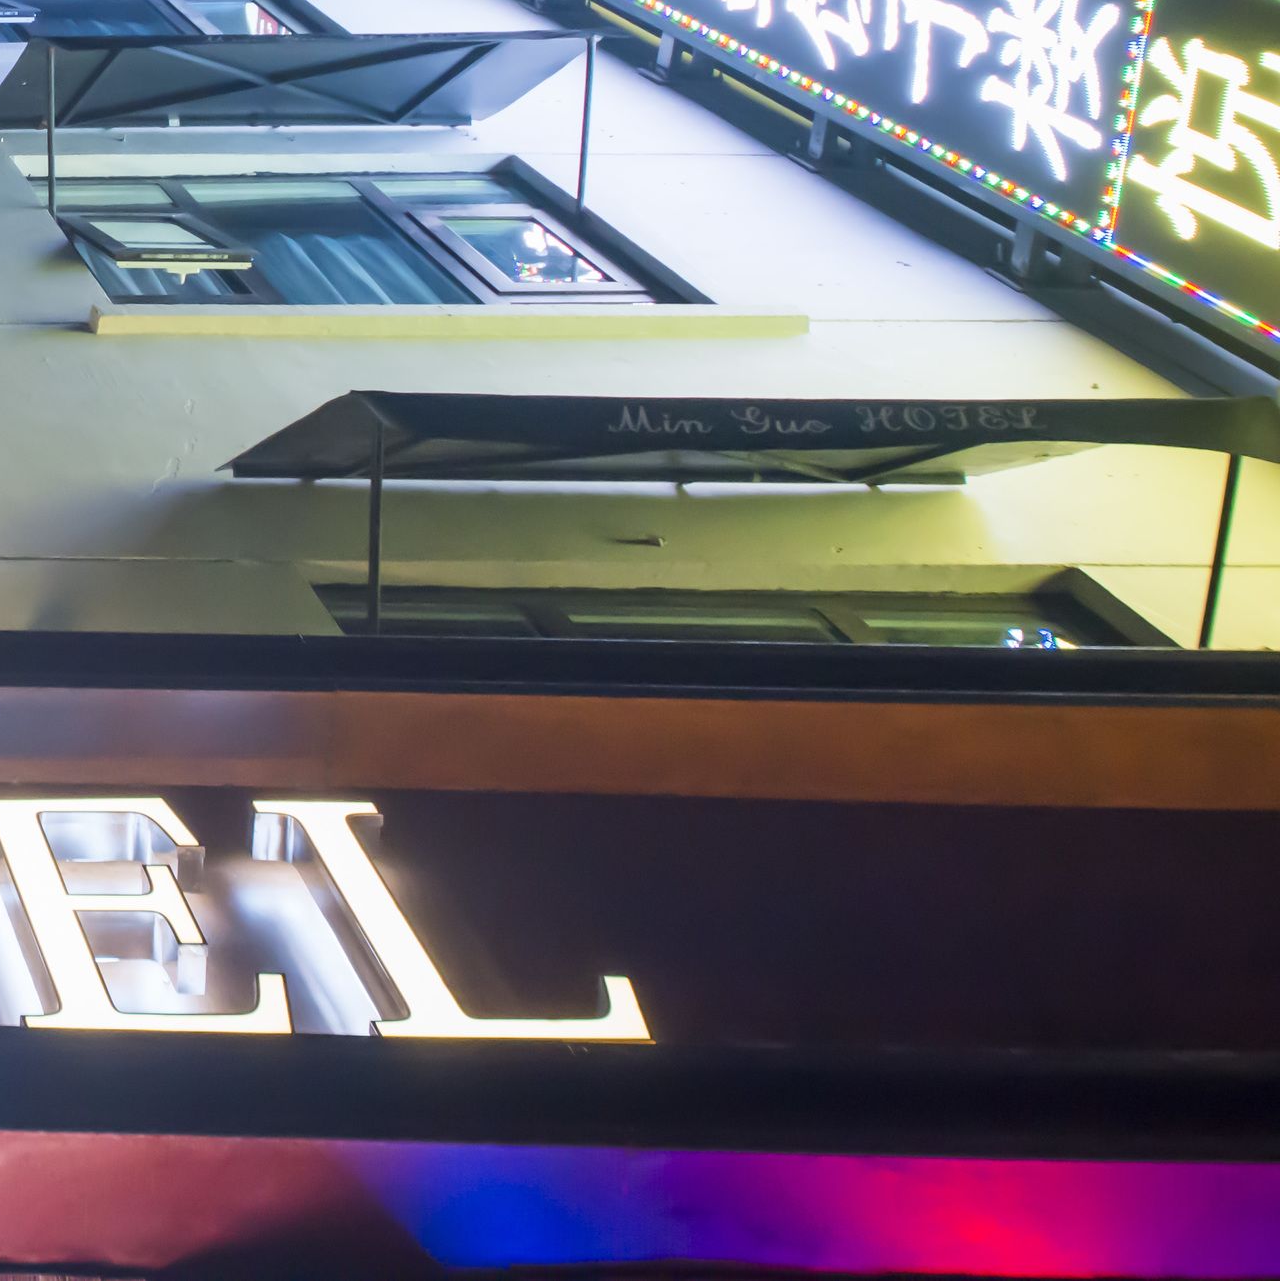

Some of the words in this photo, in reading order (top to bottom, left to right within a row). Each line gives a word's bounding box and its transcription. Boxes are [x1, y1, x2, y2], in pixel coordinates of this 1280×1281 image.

[608, 404, 713, 435] Min
[730, 405, 834, 435] Guo
[855, 405, 1048, 433] HOTEL
